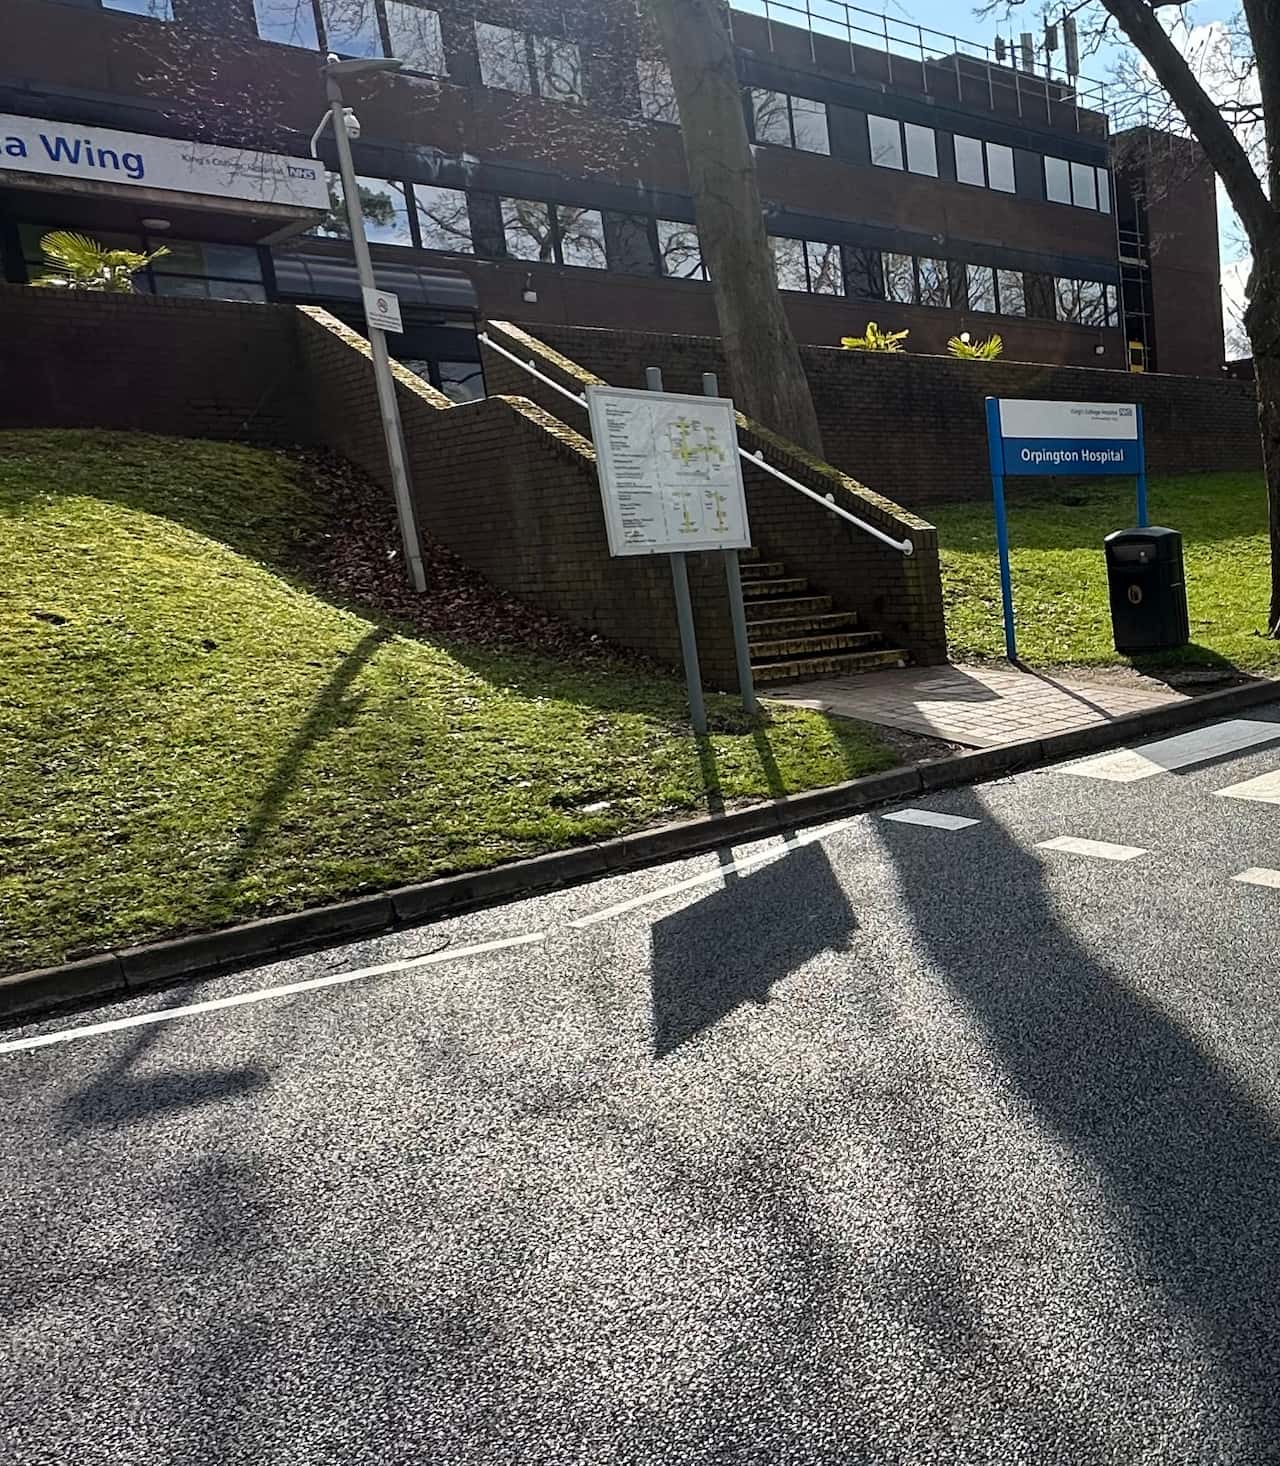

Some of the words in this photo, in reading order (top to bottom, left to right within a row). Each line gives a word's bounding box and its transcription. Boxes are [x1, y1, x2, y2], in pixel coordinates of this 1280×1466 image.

[0, 136, 27, 158] a
[39, 134, 145, 180] Wing
[289, 166, 315, 180] NHS
[1021, 447, 1079, 465] Orpington
[1081, 447, 1124, 465] Hospital
